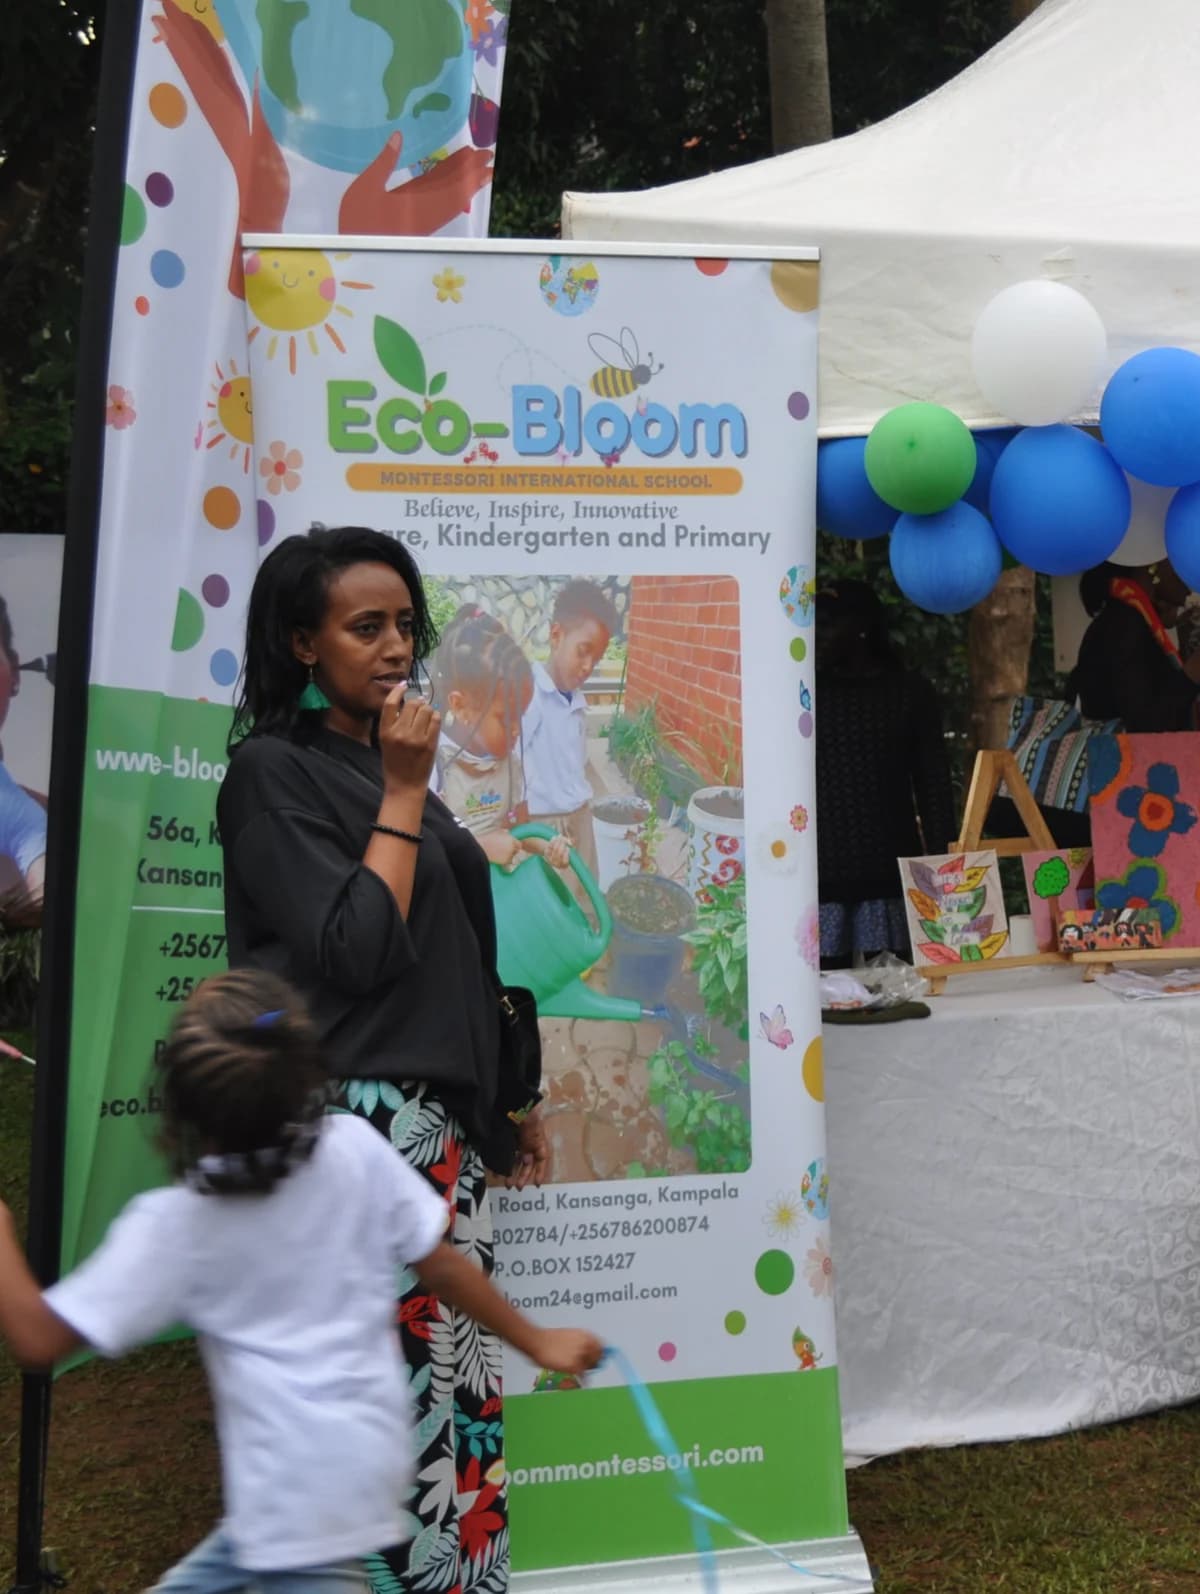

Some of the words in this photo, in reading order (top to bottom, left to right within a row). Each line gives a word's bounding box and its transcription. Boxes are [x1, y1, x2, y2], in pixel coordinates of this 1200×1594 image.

[326, 379, 749, 458] Eco-Bloom
[380, 471, 495, 488] MONTESSORI
[500, 472, 639, 489] INTERNATIONAL
[643, 474, 712, 490] SCHOOL
[403, 497, 481, 521] Believe,
[488, 499, 566, 526] Inspire,
[572, 500, 679, 521] Innovative
[437, 521, 611, 555] Kindergarten
[617, 523, 667, 549] and
[674, 524, 771, 555] Primary
[146, 815, 201, 848] 56a,
[159, 932, 228, 959] +2567
[498, 1192, 550, 1214] Road,
[556, 1190, 652, 1210] Kansanga,
[657, 1181, 739, 1205] Kampala
[494, 1256, 571, 1278] P.O.BOX
[576, 1252, 636, 1273] 152427
